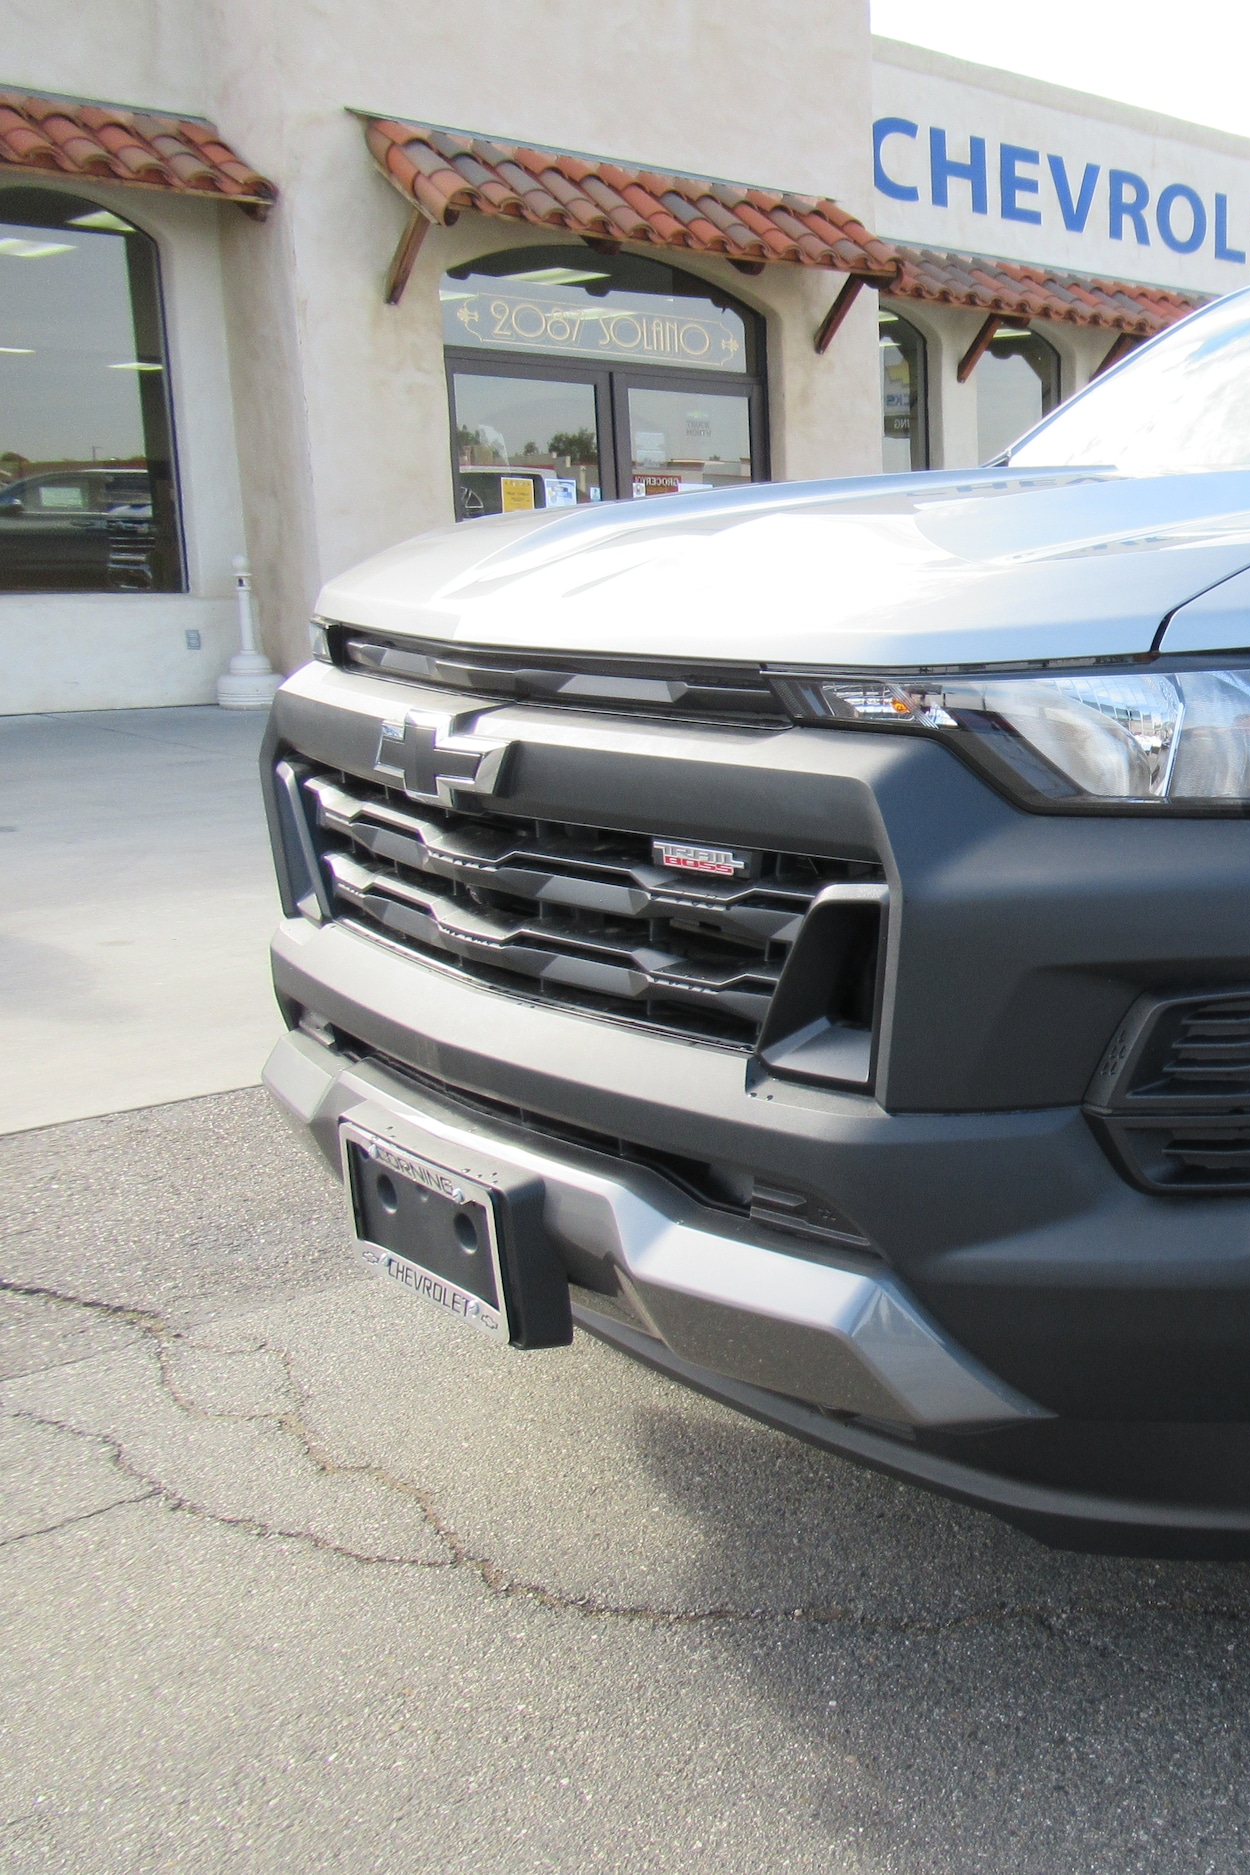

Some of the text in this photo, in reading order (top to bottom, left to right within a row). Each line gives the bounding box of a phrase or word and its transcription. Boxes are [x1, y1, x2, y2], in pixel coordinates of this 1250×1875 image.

[490, 301, 710, 355] 2087 SOLANO
[653, 841, 745, 869] TRAIL
[664, 855, 734, 876] BOSS
[388, 1257, 470, 1317] CHEVROLET
